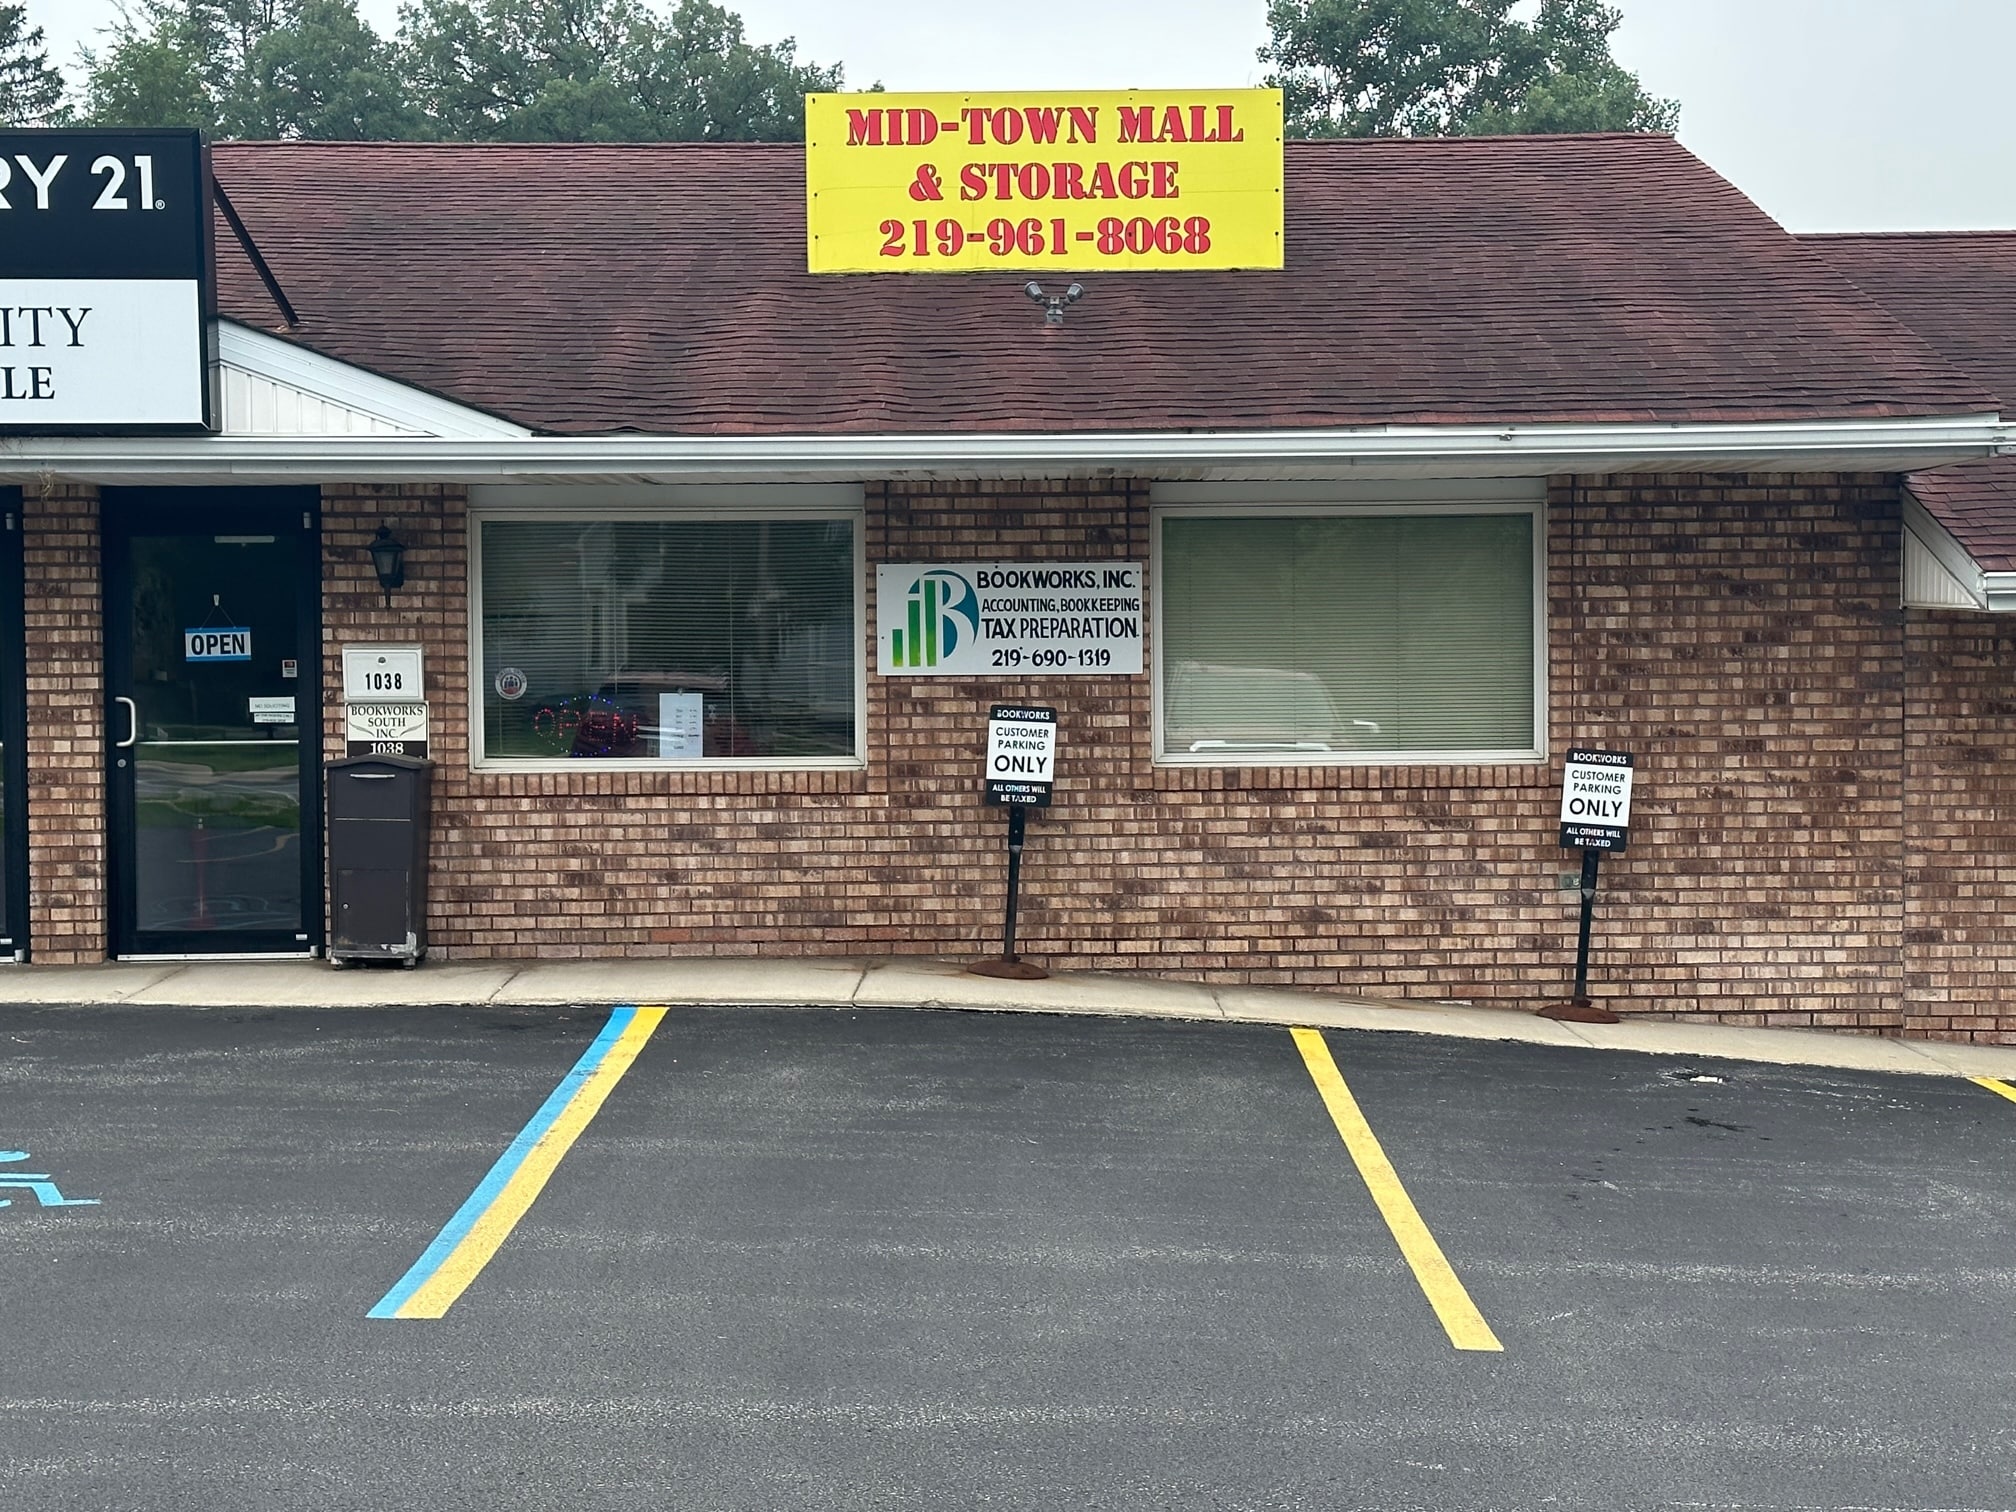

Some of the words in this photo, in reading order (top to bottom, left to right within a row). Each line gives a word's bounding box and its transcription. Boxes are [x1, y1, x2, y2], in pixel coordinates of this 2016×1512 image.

[845, 106, 1099, 146] MID-TOWN
[1116, 104, 1244, 144] MALL
[908, 163, 943, 202] &
[960, 161, 1179, 201] STORAGE
[878, 216, 1212, 257] 219-961-8068
[0, 306, 92, 347] ITY
[1, 366, 56, 400] LE
[977, 570, 1100, 590] BOOKWORKS,
[1103, 569, 1136, 588] INC.
[1061, 597, 1140, 611] BOOKKEEPING
[981, 617, 1017, 639] TAX
[1020, 617, 1137, 639] PREPARATION
[191, 634, 245, 655] OPEN
[992, 648, 1111, 667] 219-690-1319
[365, 673, 402, 690] 1038
[351, 705, 423, 716] BOOKWORKS
[997, 709, 1050, 720] BOOKWORKS
[368, 717, 406, 727] SOUTH
[534, 708, 637, 744] OPEN
[376, 728, 399, 739] INC.
[996, 726, 1049, 738] CUSTOMER
[370, 742, 404, 754] 1038
[998, 739, 1046, 750] PARKING
[994, 754, 1047, 773] ONLY
[1573, 752, 1627, 764] BOOKWORKS
[1571, 769, 1625, 783] CUSTOMER
[992, 783, 1004, 792] ALL
[1005, 784, 1030, 793] OTHERS
[1031, 785, 1046, 794] WILL
[1573, 782, 1622, 795] PARKING
[1000, 794, 1010, 802] BE
[1569, 797, 1622, 818] ONLY
[1566, 826, 1578, 835] ALL
[1579, 827, 1604, 837] OTHERS
[1605, 829, 1621, 838] WILL
[1574, 837, 1584, 845] BE
